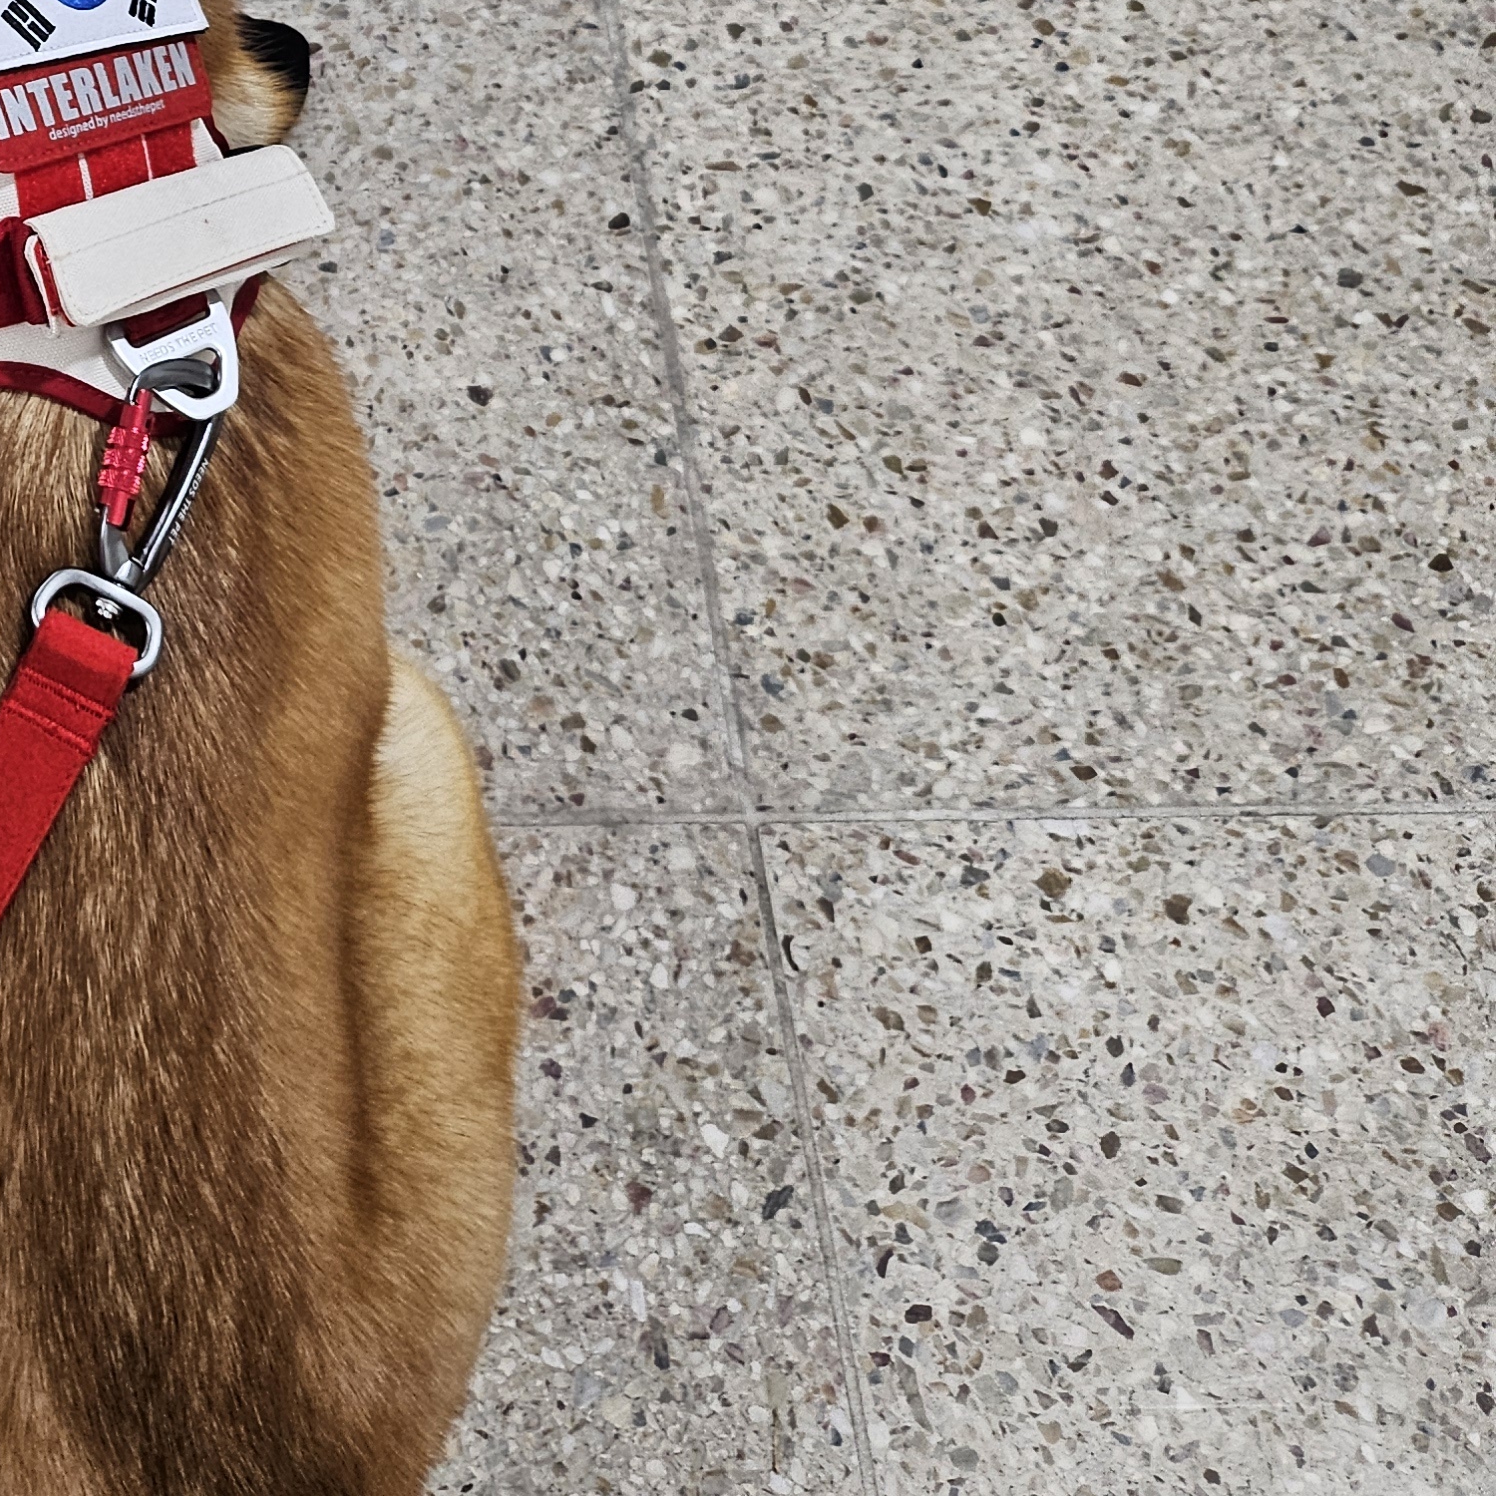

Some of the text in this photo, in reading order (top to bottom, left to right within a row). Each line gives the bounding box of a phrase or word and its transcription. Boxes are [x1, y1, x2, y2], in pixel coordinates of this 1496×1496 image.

[48, 99, 166, 141] designed by needsthepet
[139, 322, 218, 363] NEEDS THE PET
[168, 458, 209, 545] NEEDS THE PET
